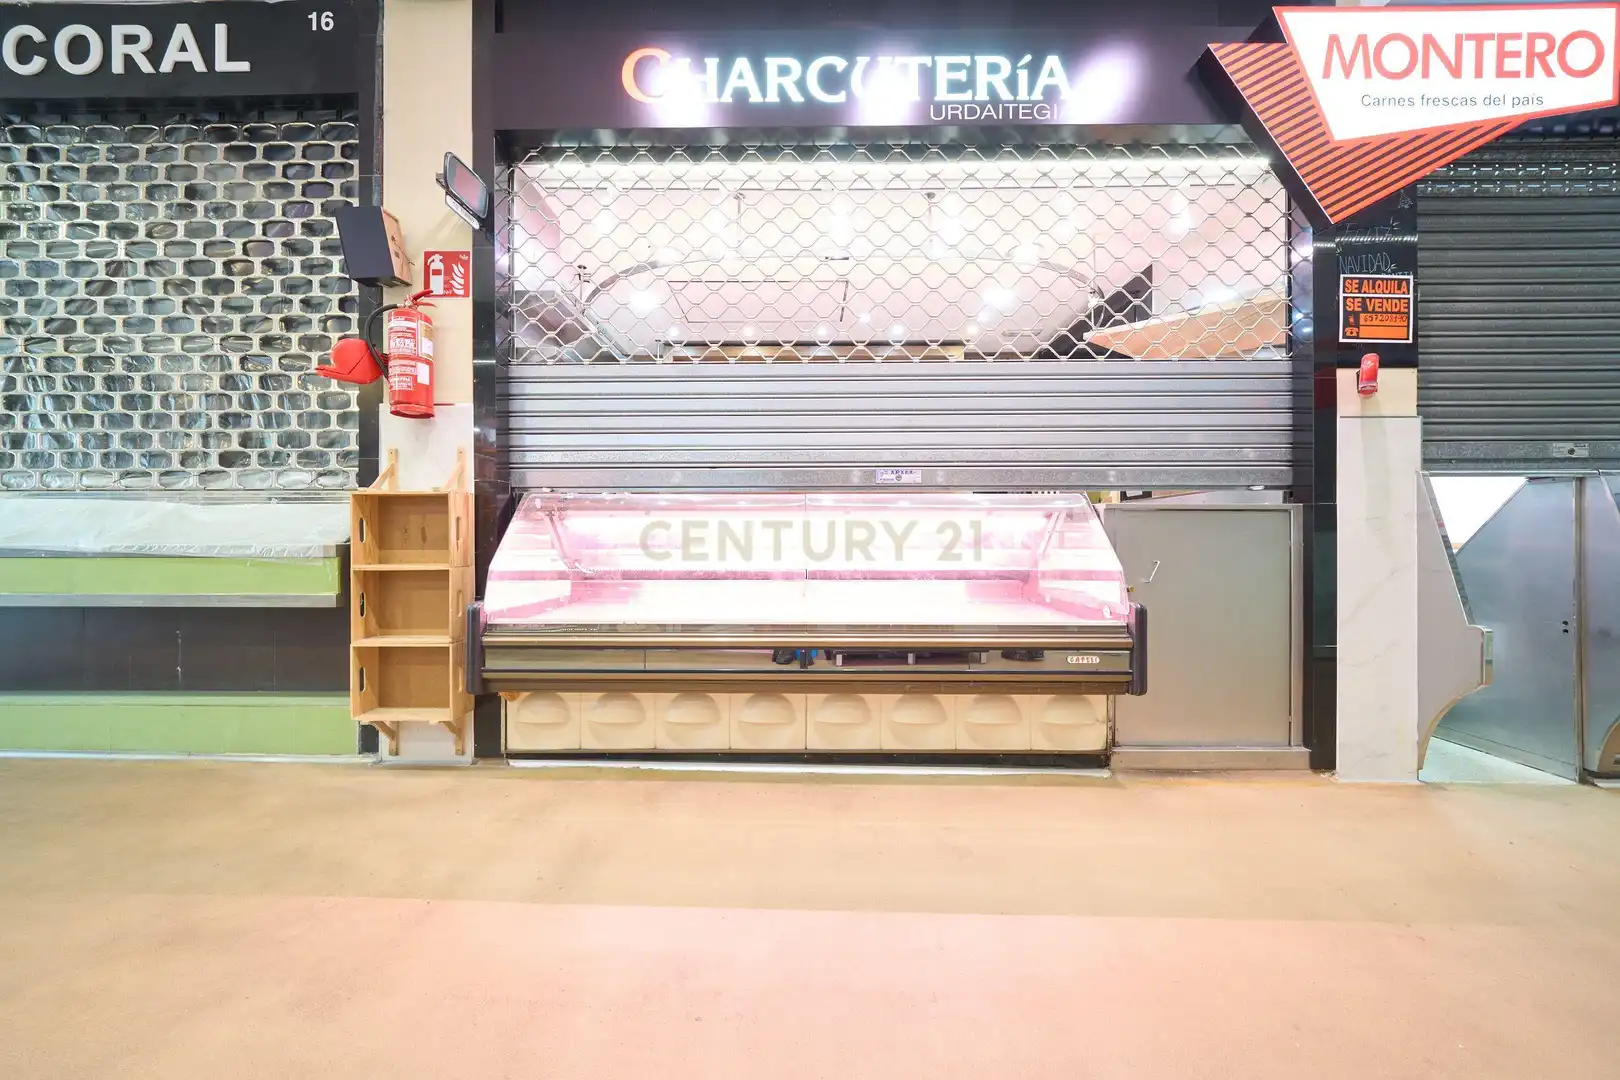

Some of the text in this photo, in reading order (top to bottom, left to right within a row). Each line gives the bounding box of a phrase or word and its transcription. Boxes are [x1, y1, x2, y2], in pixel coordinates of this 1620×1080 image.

[307, 11, 335, 31] 16
[2, 23, 251, 76] CORAL
[1322, 30, 1605, 80] MONTERO
[1361, 93, 1544, 109] Carnes frescas del país
[930, 103, 1067, 121] URDAITEGI
[1339, 252, 1391, 275] NAVIDAD
[1344, 279, 1409, 294] SE ALQUILA
[1345, 297, 1409, 312] SE VENDE
